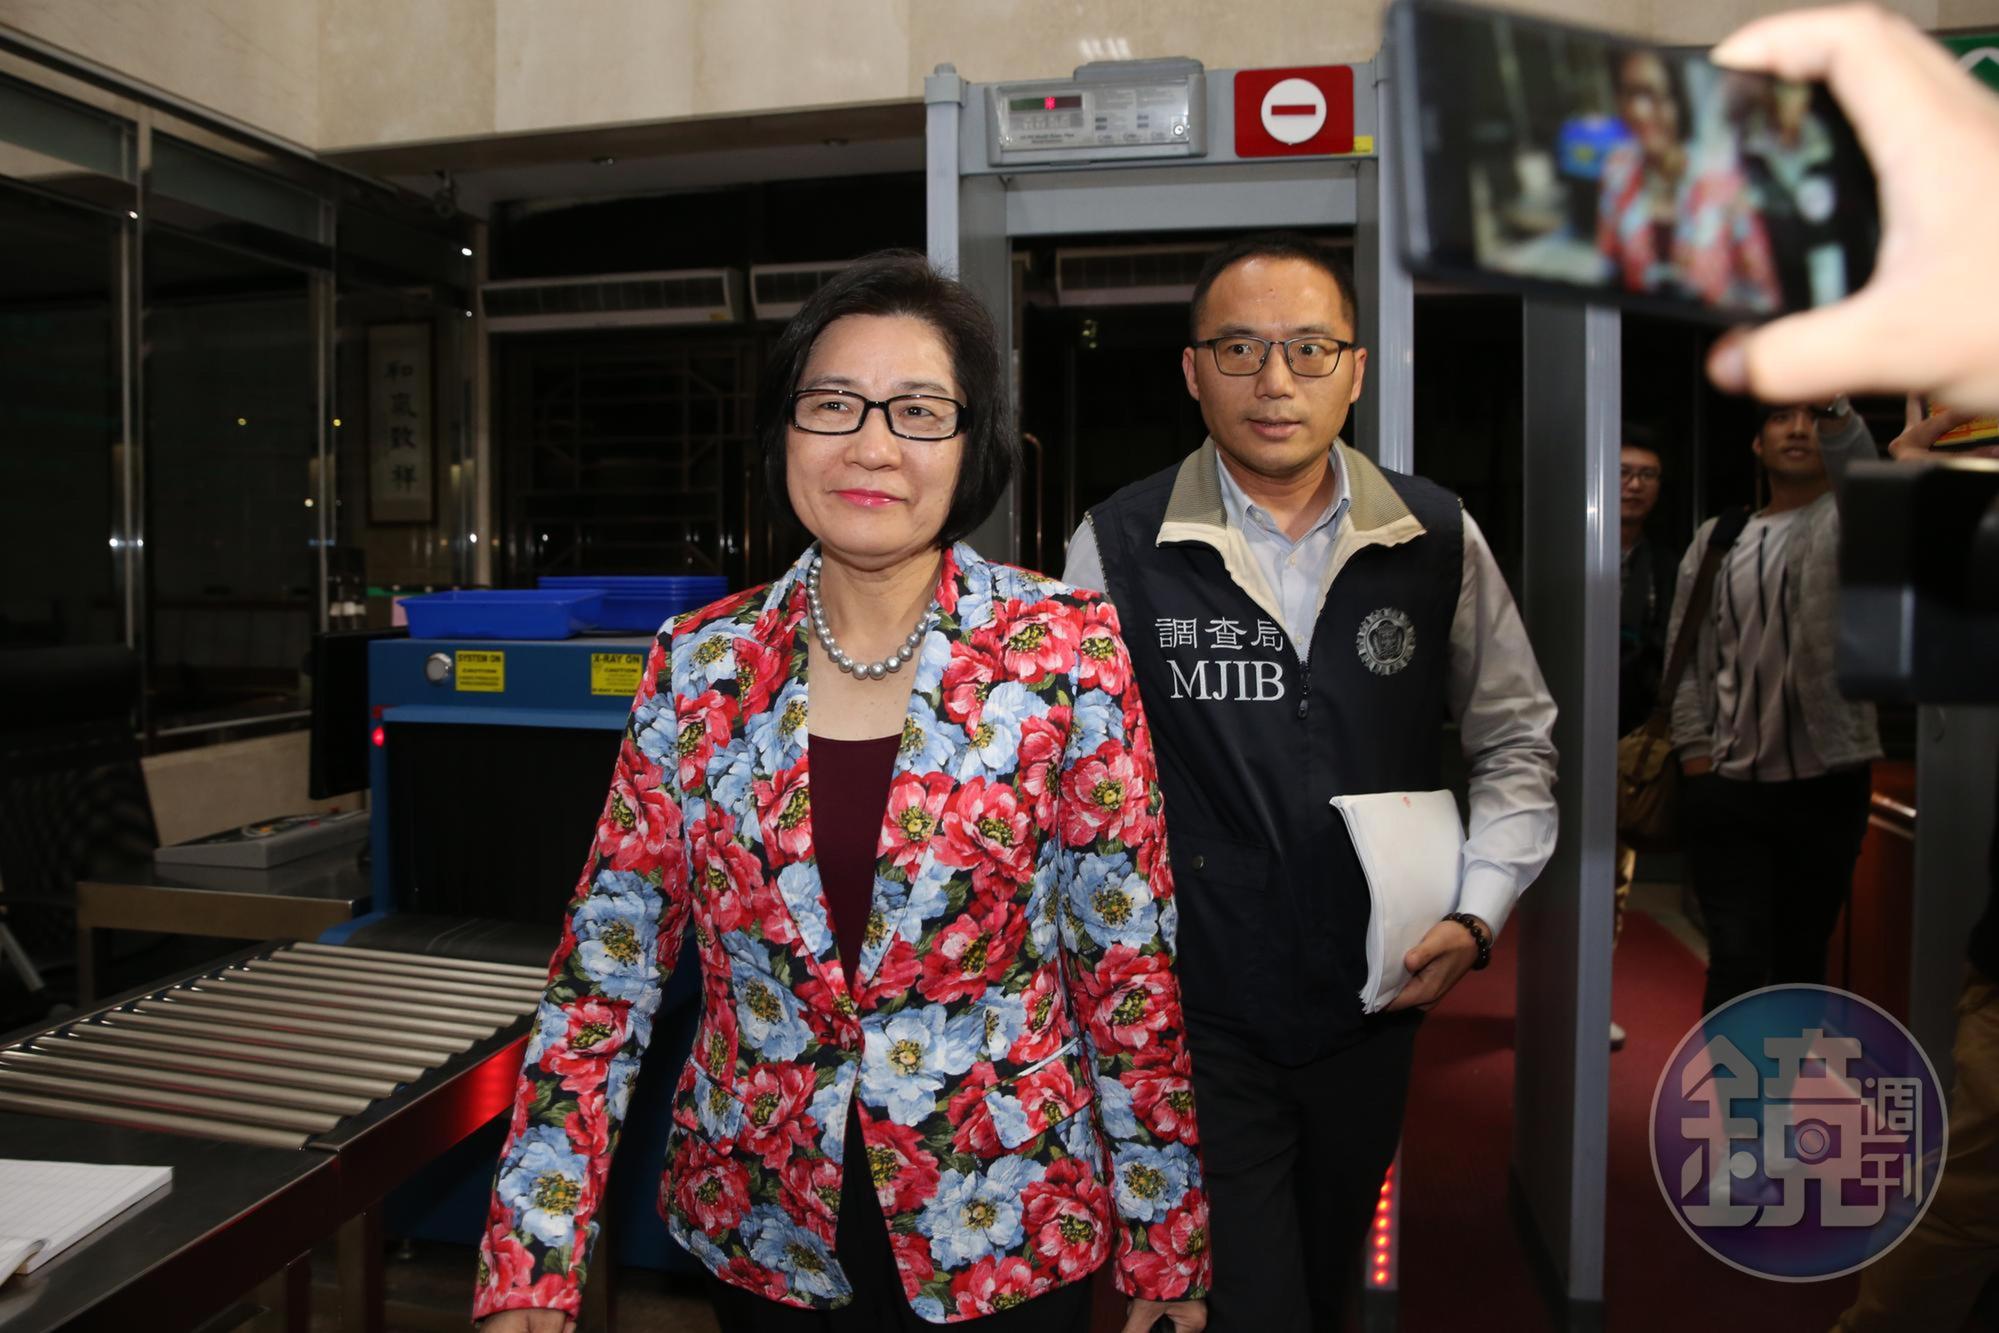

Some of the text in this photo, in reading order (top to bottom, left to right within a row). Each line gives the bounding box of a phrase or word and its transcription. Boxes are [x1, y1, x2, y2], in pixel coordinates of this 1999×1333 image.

[1155, 616, 1283, 651] 調查局
[458, 653, 487, 663] SYSTEM
[593, 654, 640, 664] X-RAY ON
[1166, 659, 1285, 701] MJIB
